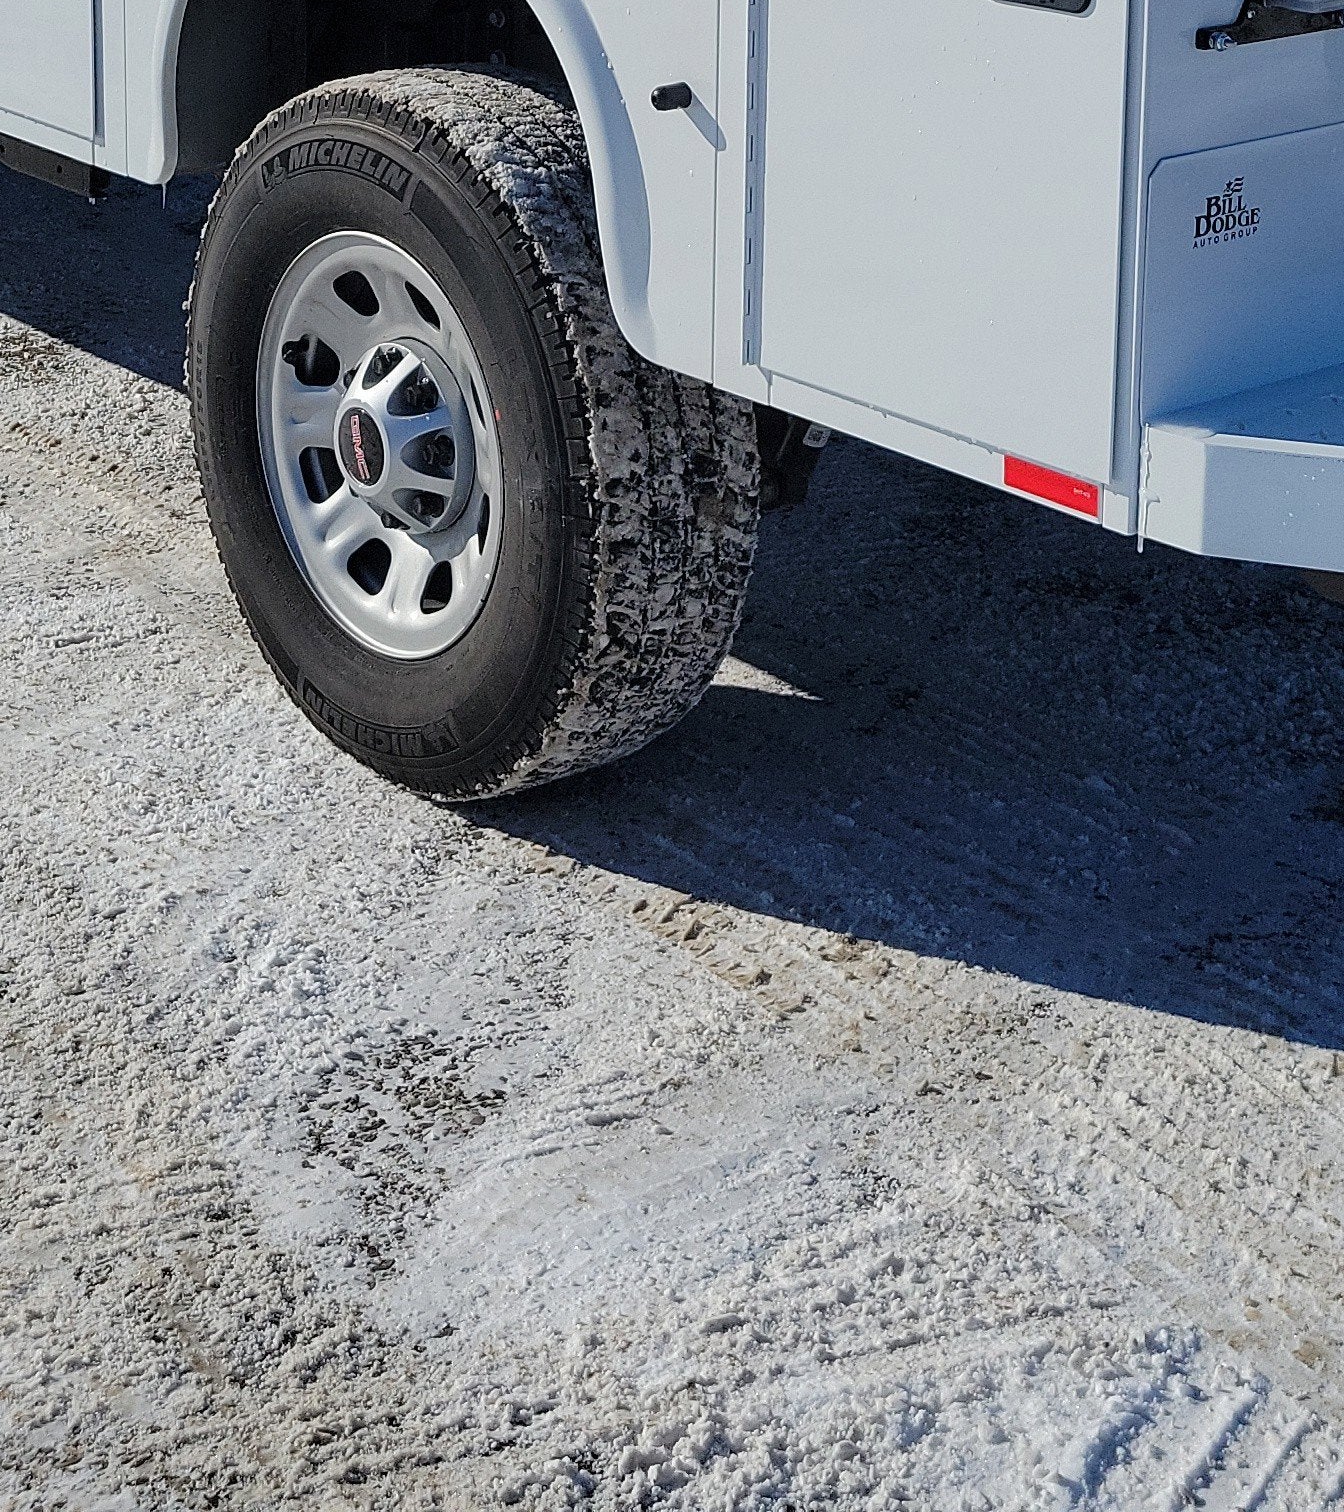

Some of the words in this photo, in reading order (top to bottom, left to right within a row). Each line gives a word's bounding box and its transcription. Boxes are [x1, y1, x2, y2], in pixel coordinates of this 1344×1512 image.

[288, 140, 408, 192] MICHELIN
[1193, 208, 1261, 239] DODGE
[1205, 195, 1247, 218] BILL
[1192, 235, 1220, 249] AUTO
[1223, 226, 1258, 242] GROUP
[350, 414, 371, 480] GMC
[305, 687, 424, 757] MICHELIN
